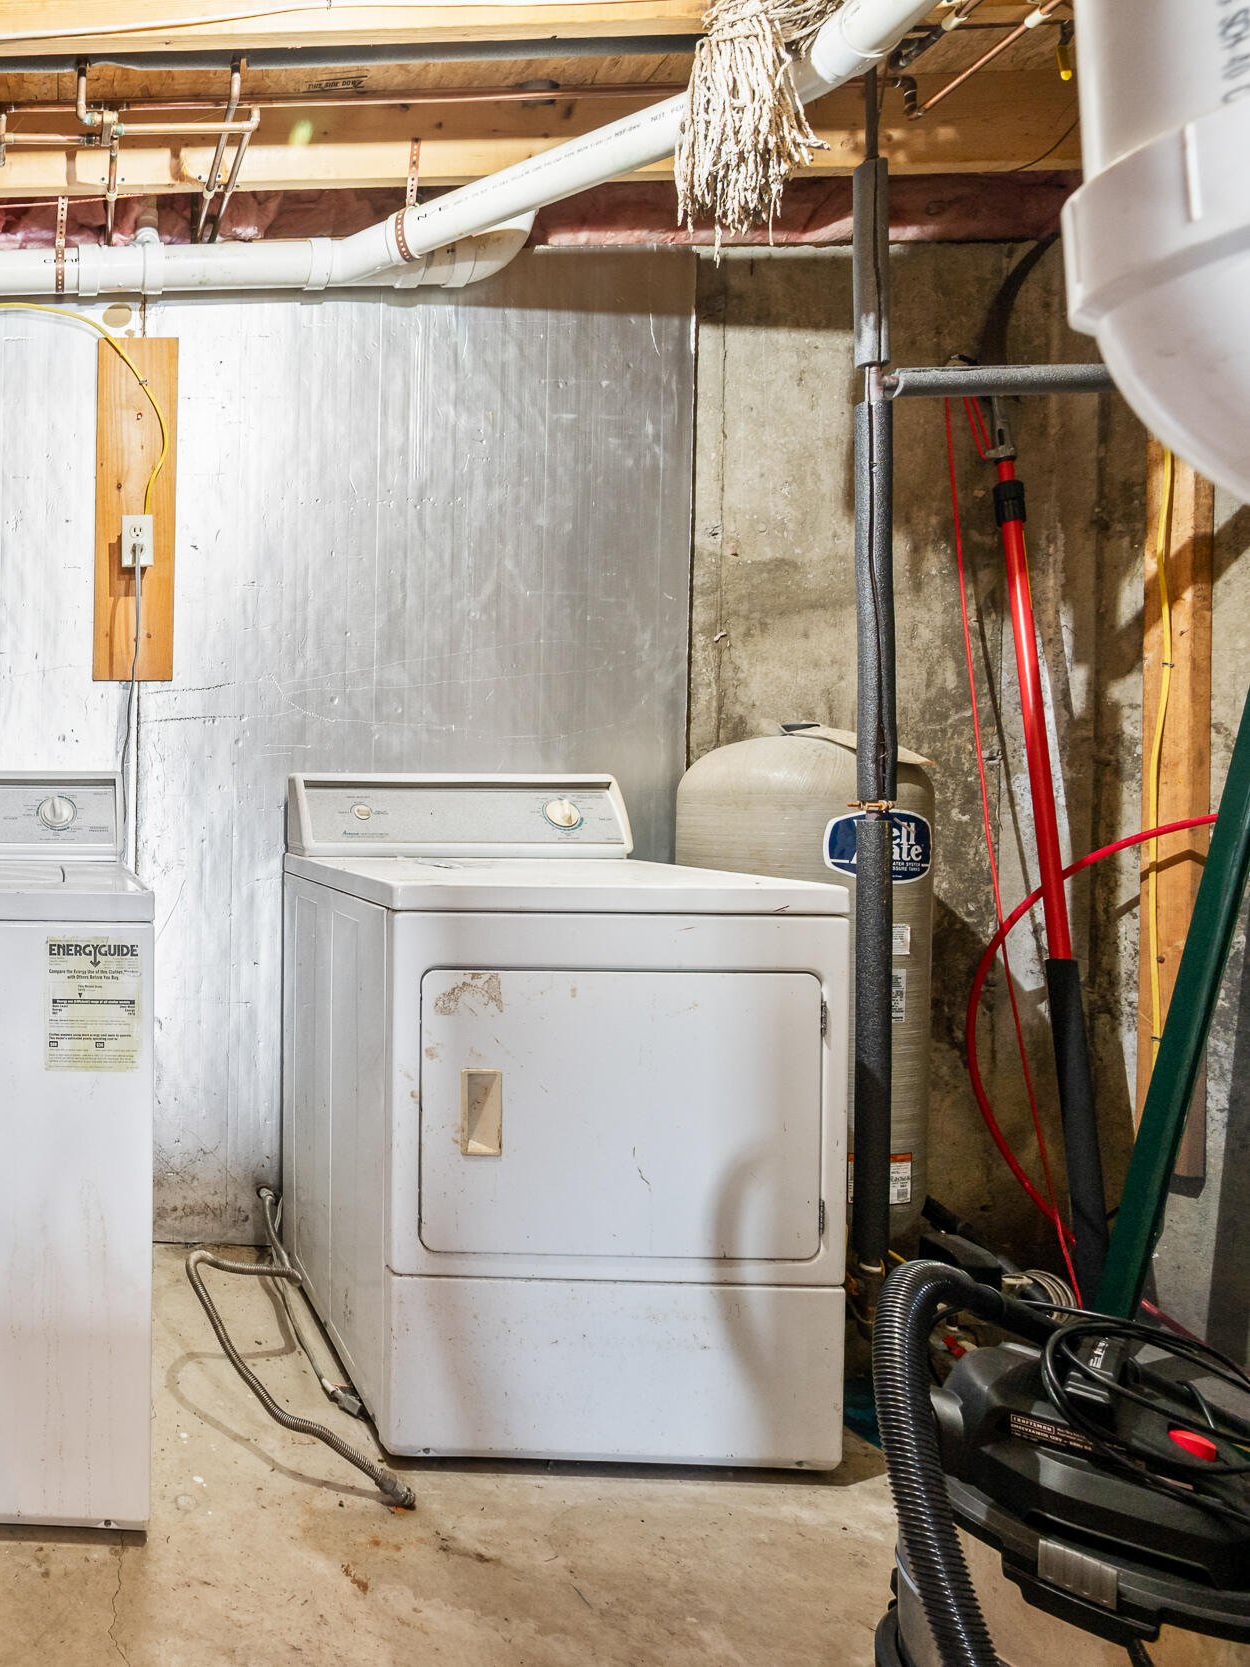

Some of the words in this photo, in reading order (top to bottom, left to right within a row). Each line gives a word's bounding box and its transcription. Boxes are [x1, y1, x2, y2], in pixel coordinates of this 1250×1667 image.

[892, 821, 916, 845] ell
[48, 943, 138, 957] ENERGYGUIDE
[1013, 1416, 1053, 1431] CRAFTSMAN
